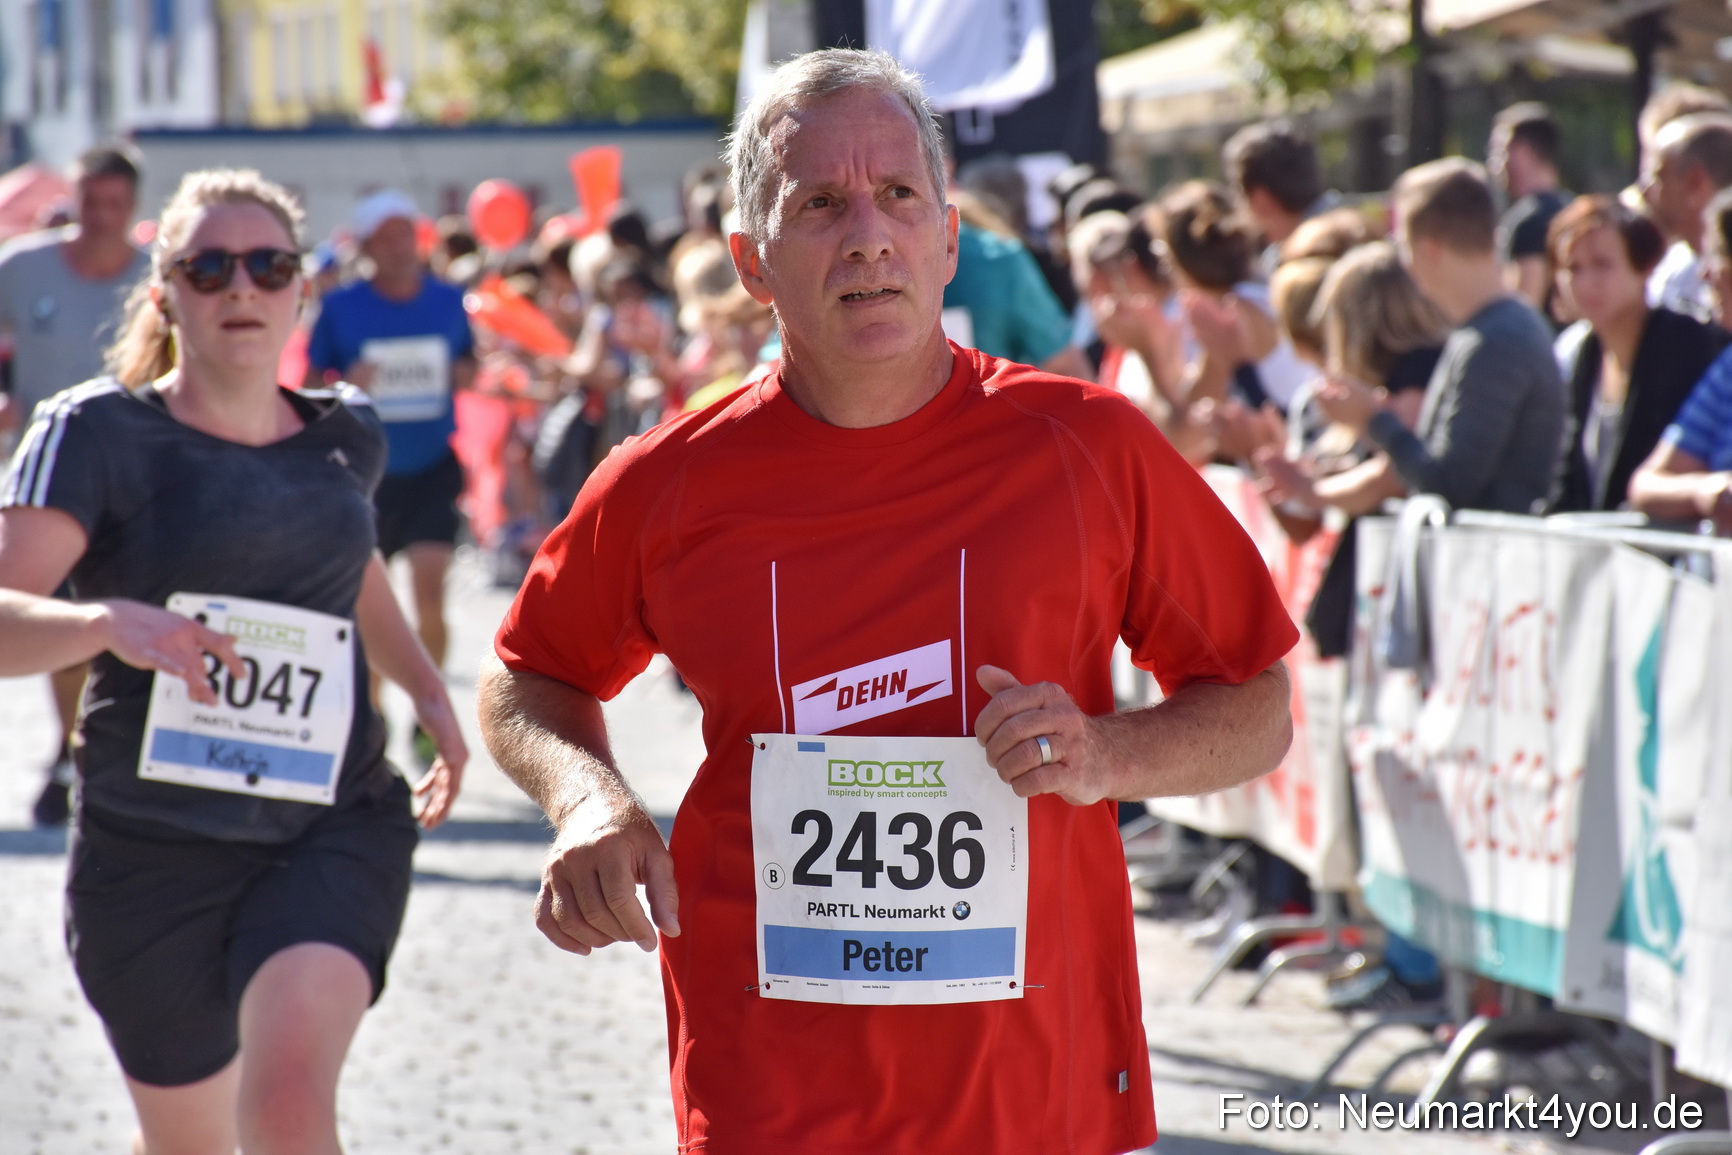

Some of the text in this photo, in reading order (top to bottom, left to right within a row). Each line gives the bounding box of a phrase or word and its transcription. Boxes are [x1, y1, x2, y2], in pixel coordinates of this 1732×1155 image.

[836, 668, 908, 712] DEHN
[827, 759, 946, 787] BOCK
[827, 788, 948, 799] inspired by smart concepts
[790, 809, 986, 890] 2436
[769, 869, 778, 883] B
[807, 901, 860, 918] PARTL
[864, 904, 946, 919] Neumarkt
[843, 939, 929, 972] Peter
